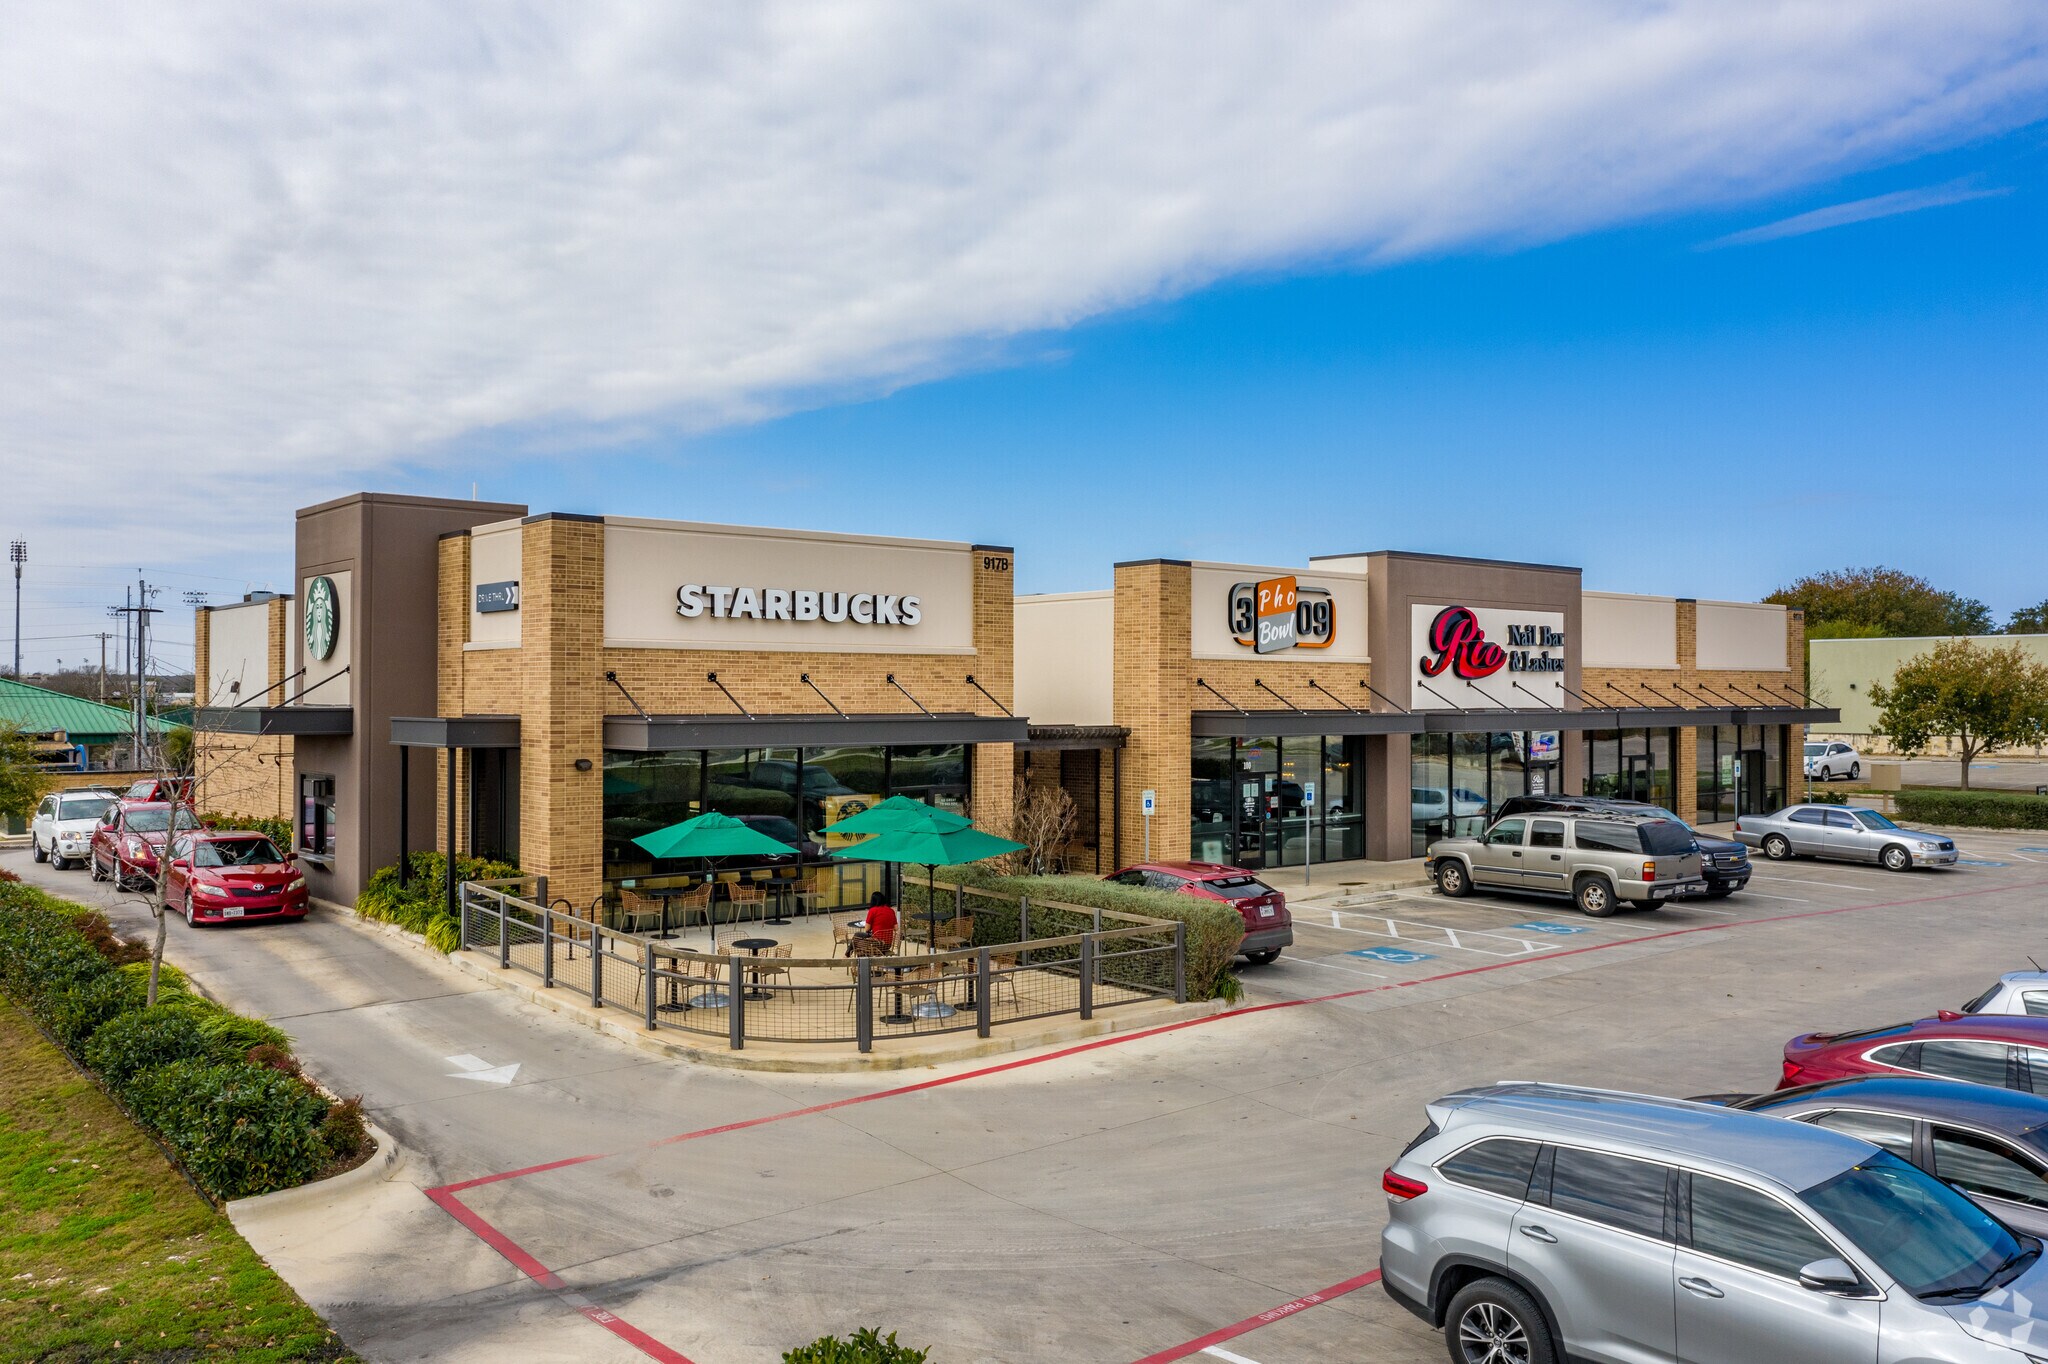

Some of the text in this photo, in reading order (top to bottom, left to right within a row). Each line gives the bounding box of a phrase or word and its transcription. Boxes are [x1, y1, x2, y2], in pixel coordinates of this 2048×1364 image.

[983, 556, 1008, 571] 917B
[677, 583, 922, 626] STARBUCKS
[1259, 584, 1295, 612] Pho
[1236, 597, 1329, 636] 3 09
[1258, 612, 1297, 645] Bowl
[1420, 605, 1508, 680] Rio
[1507, 624, 1565, 647] Nail Bar
[1508, 650, 1521, 672] &
